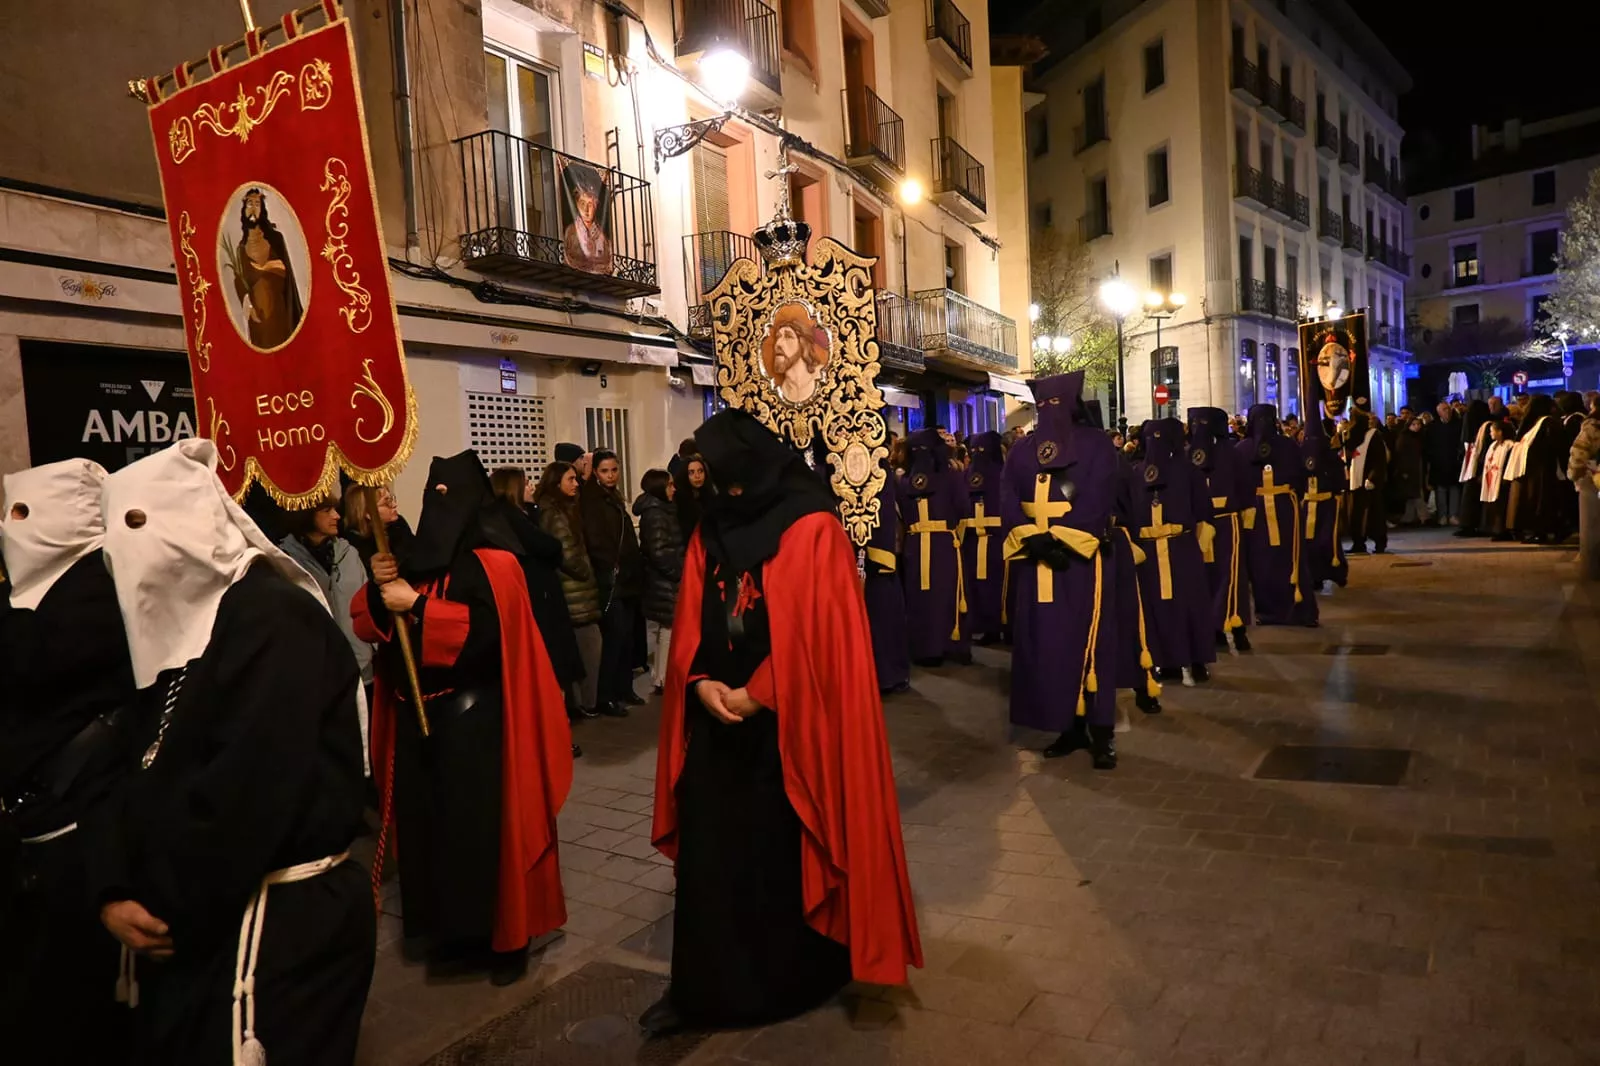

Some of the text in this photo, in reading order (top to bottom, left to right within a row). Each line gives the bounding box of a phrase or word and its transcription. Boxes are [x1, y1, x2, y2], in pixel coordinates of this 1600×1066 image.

[600, 375, 608, 388] 5
[255, 389, 315, 416] Ecce
[81, 409, 196, 443] AMBA
[257, 423, 326, 452] Homo
